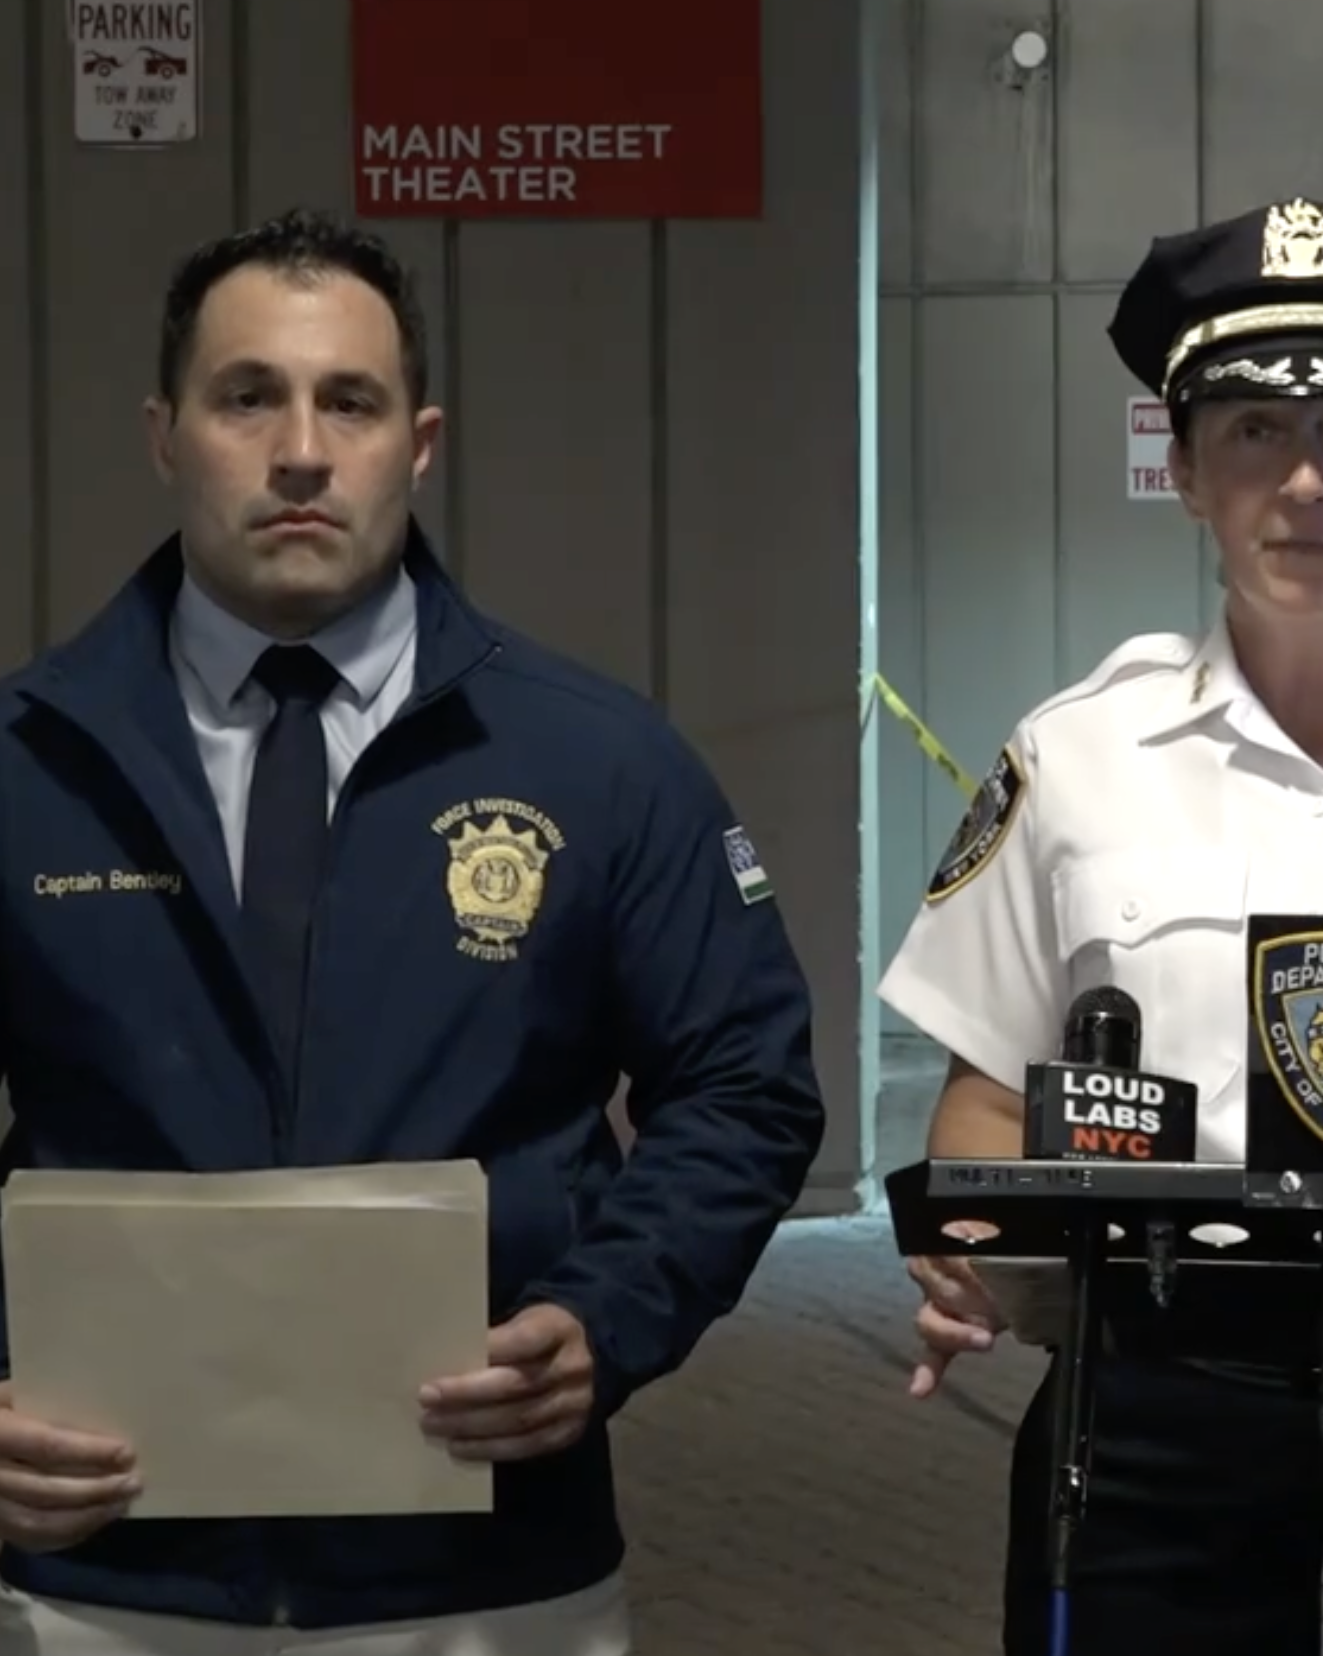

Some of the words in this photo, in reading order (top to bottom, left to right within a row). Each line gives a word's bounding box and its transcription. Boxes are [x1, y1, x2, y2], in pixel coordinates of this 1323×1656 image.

[78, 3, 191, 40] PARKING
[95, 86, 128, 105] TOW
[135, 86, 177, 105] AWAY
[112, 110, 158, 130] ZONE
[363, 125, 481, 159] MAIN
[498, 125, 672, 159] STREET
[362, 167, 576, 201] THEATER
[34, 872, 102, 899] Captain
[109, 869, 182, 895] Bentley
[1270, 1021, 1301, 1074] CITY
[1297, 1078, 1323, 1107] OF
[1063, 1071, 1165, 1106] LOUD
[1064, 1099, 1162, 1135] LABS
[1073, 1127, 1151, 1159] NYC
